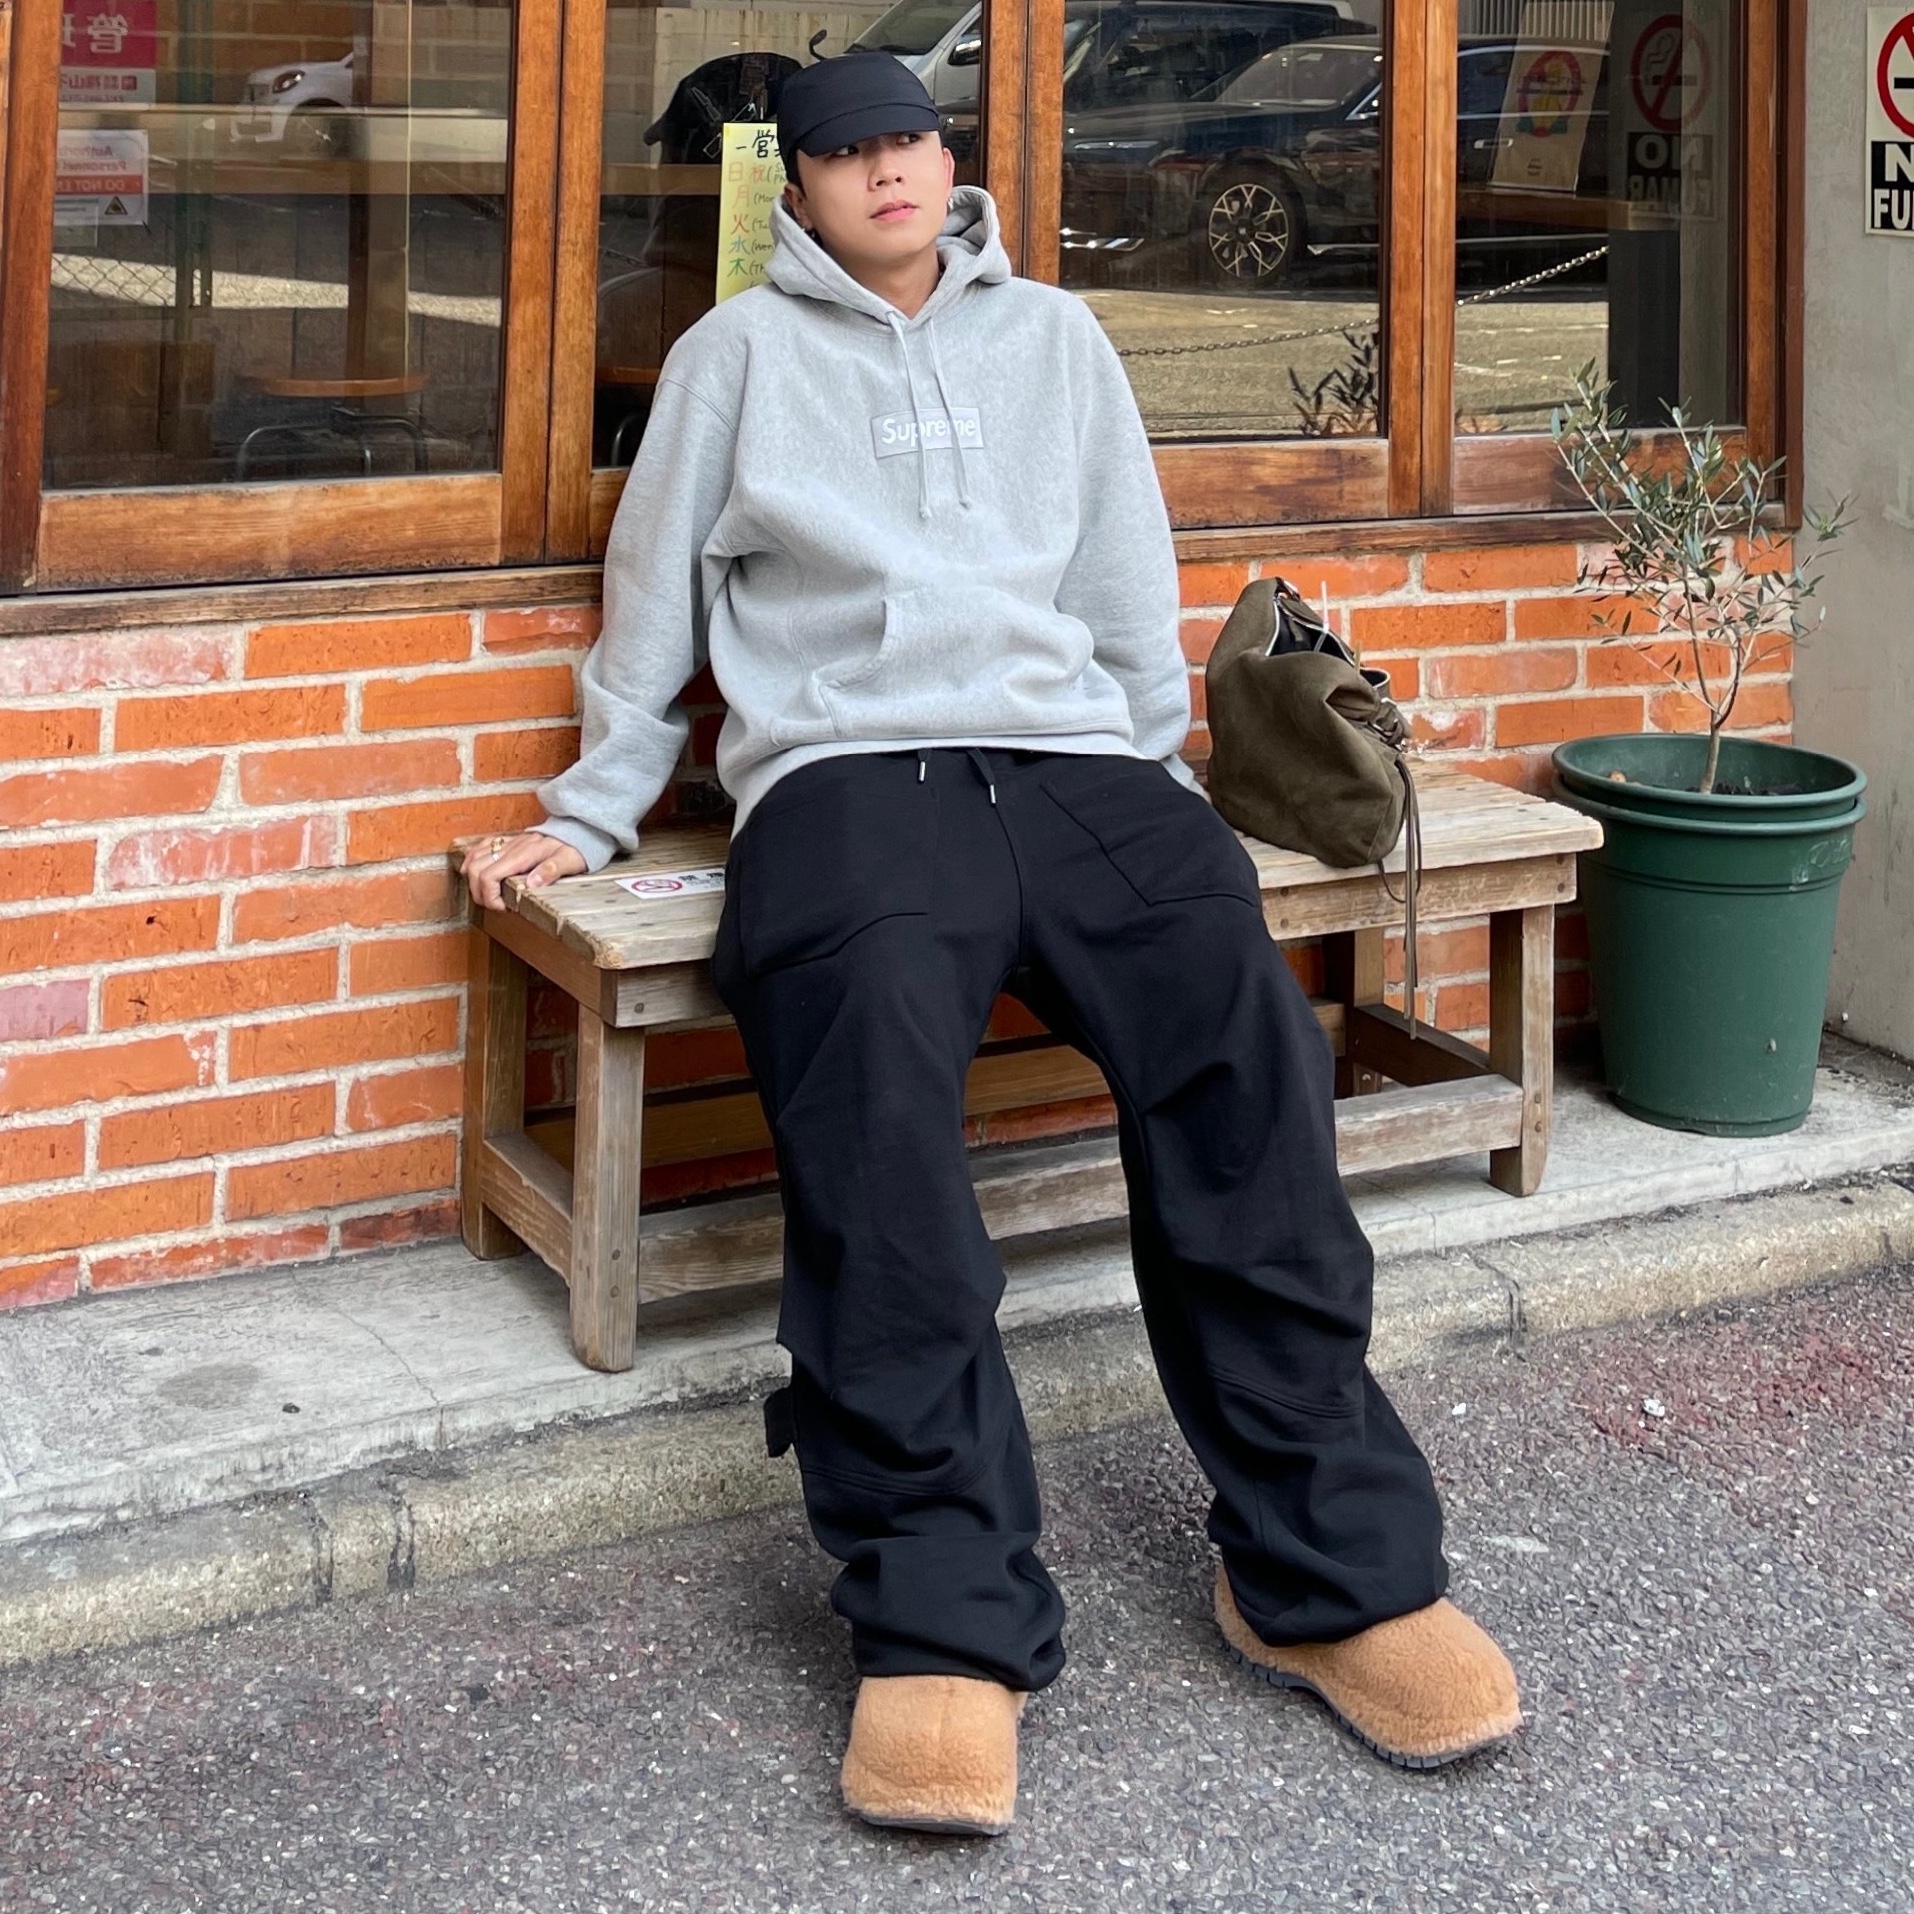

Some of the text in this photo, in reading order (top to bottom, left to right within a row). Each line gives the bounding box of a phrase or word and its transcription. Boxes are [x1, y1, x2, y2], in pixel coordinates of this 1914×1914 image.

[1873, 188, 1914, 230] FU
[730, 213, 751, 235] 火
[728, 235, 751, 255] 水
[726, 258, 748, 277] 木
